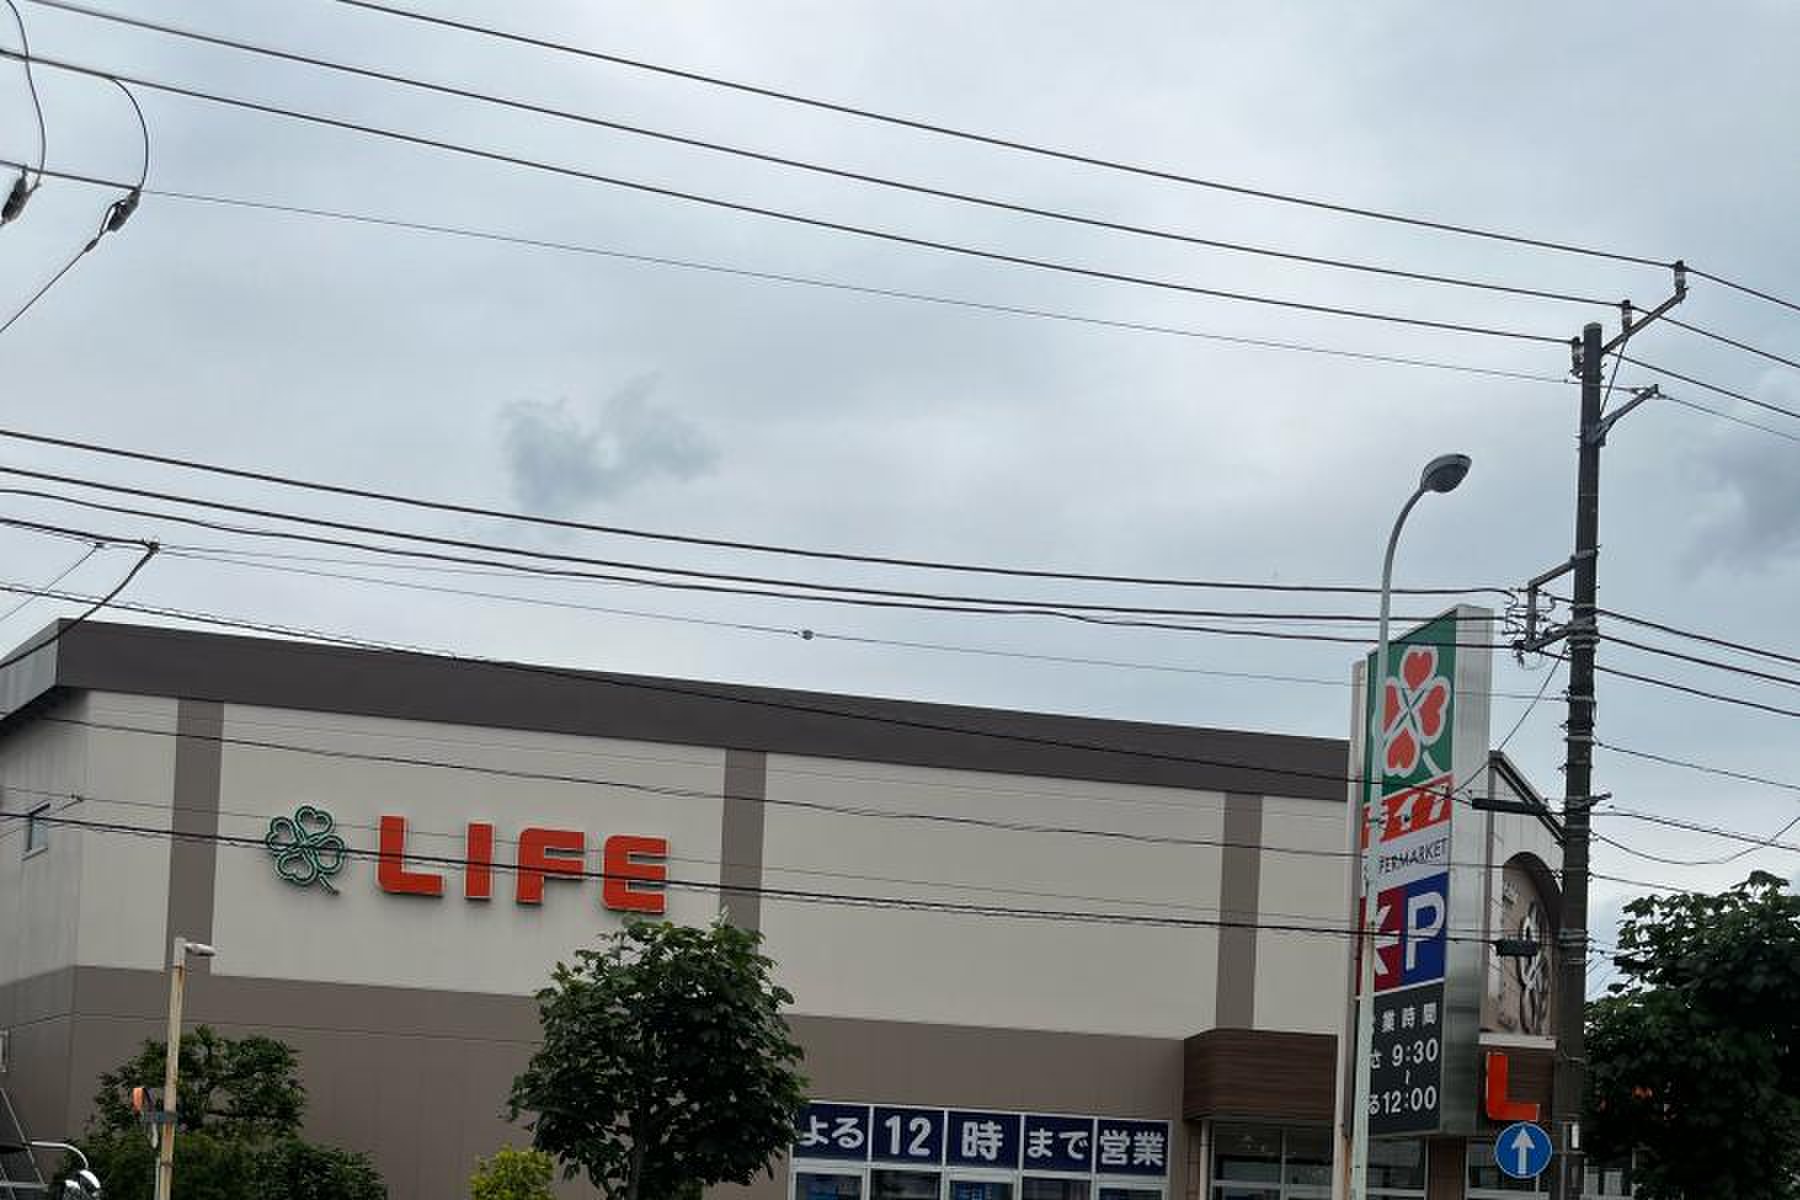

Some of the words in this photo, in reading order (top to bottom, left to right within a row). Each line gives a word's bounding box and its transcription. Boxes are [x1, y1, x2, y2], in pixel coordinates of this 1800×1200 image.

[377, 815, 670, 915] LIFE
[1405, 891, 1446, 972] P
[1380, 1001, 1438, 1033] 業時間
[1391, 1037, 1439, 1067] 9:30
[1382, 1085, 1438, 1114] 12:00
